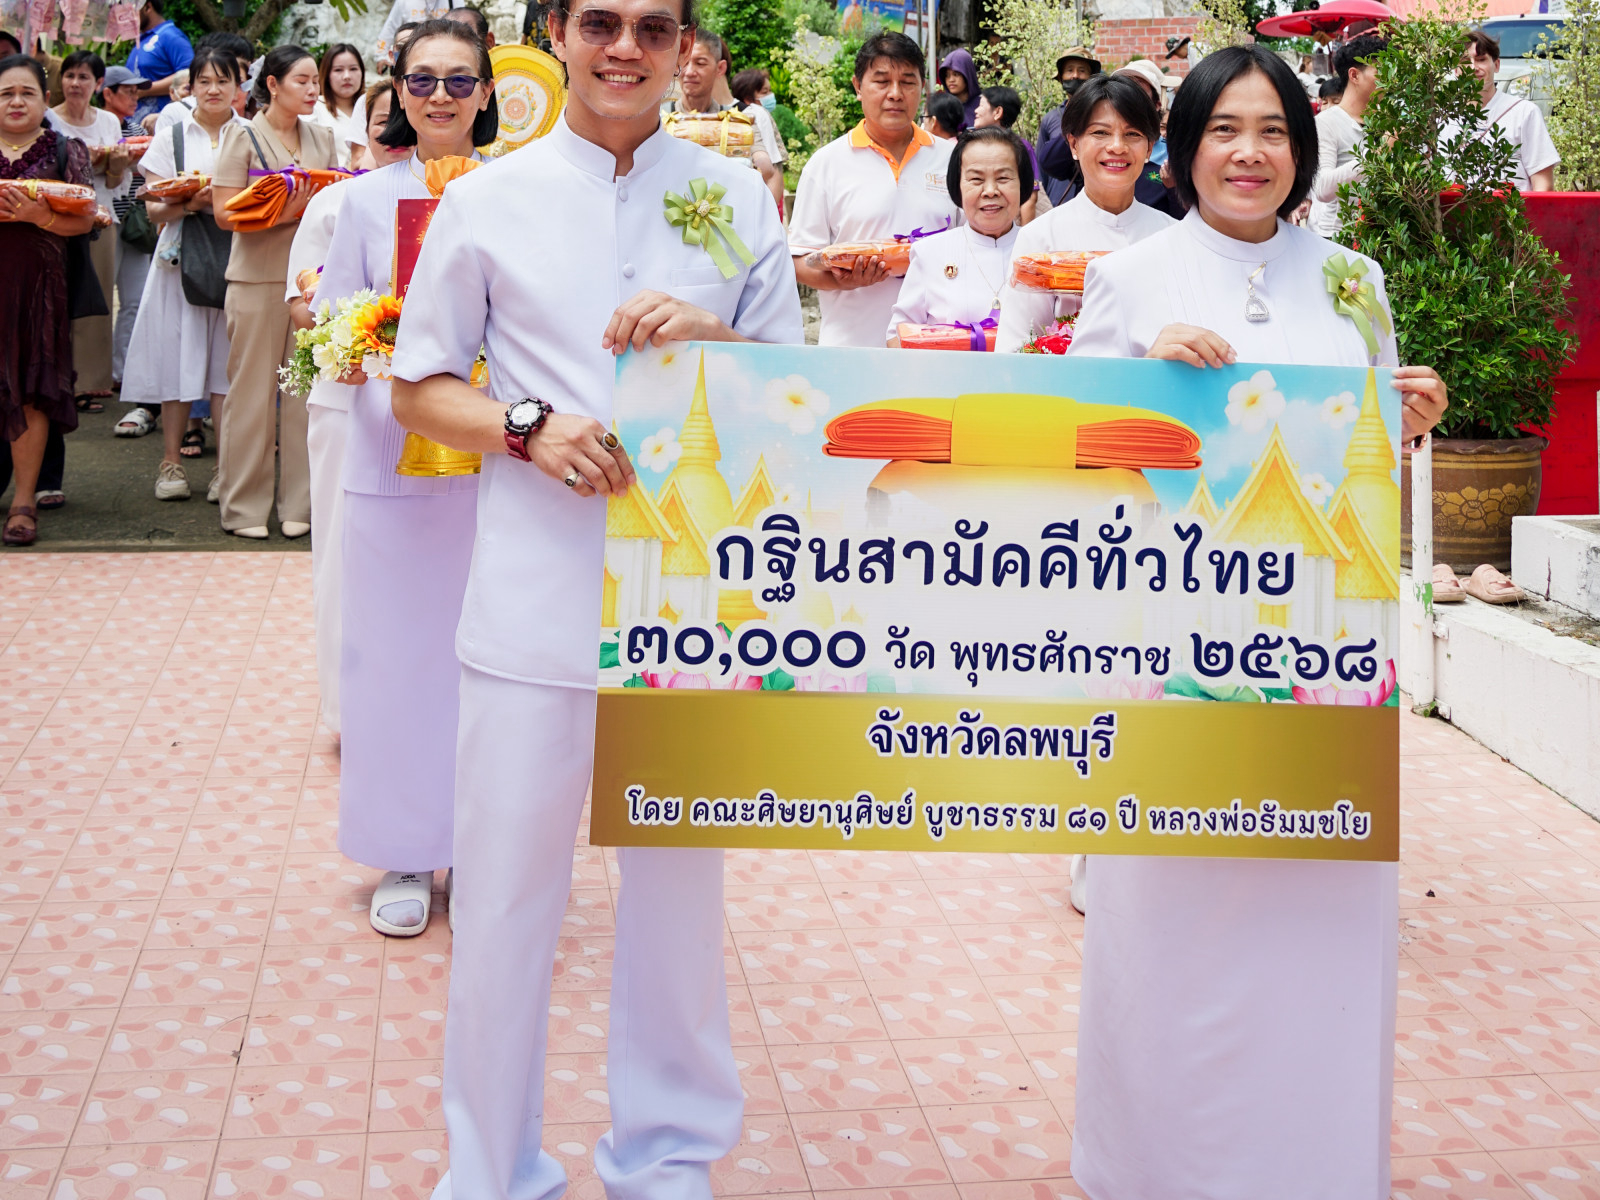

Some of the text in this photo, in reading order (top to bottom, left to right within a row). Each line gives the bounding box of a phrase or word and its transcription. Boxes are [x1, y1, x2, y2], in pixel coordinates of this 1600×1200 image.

[717, 505, 1295, 603] กฐินสามัคคีทั่วไทย
[628, 626, 1377, 687] ๓๐,๐๐๐ วัด พุทธศักราช ๒๕๖๘
[868, 709, 1116, 776] จังหวัดลพบุรี
[628, 789, 1369, 838] โดย คณะศิษยานุศิษย์ บูชาธรรม ๘๑ ปี หลวงพ่อธัมมชโย
